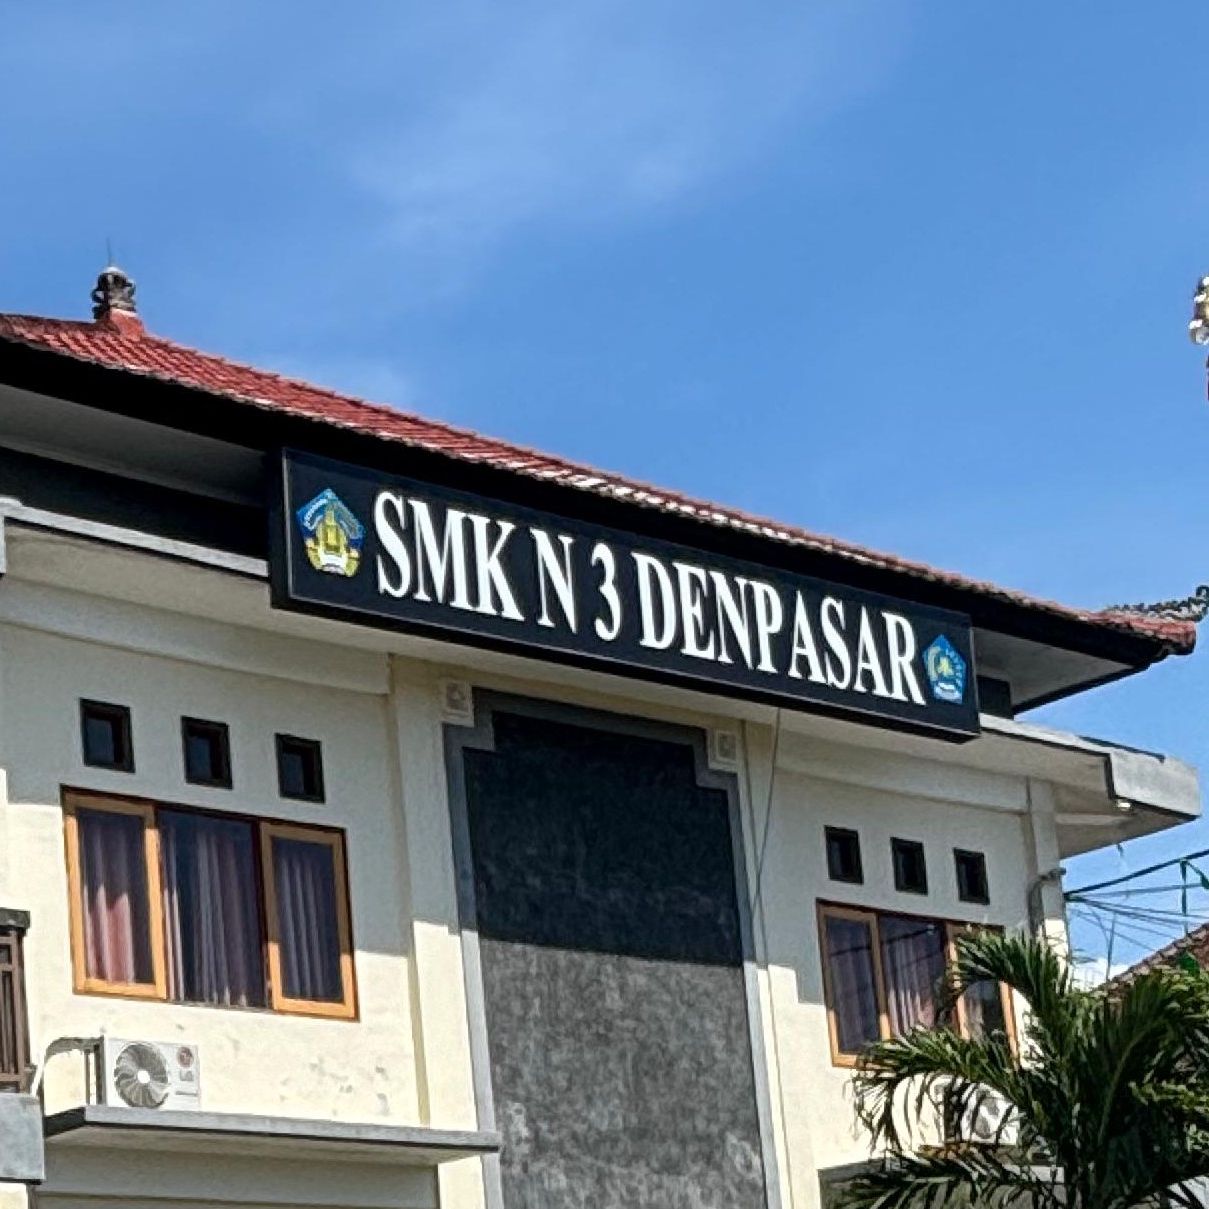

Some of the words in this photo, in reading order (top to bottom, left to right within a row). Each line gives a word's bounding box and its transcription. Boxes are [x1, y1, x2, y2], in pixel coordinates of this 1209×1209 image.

[374, 490, 525, 622] SMK
[529, 528, 578, 634] N
[592, 542, 623, 642] 3
[631, 552, 927, 706] DENPASAR
